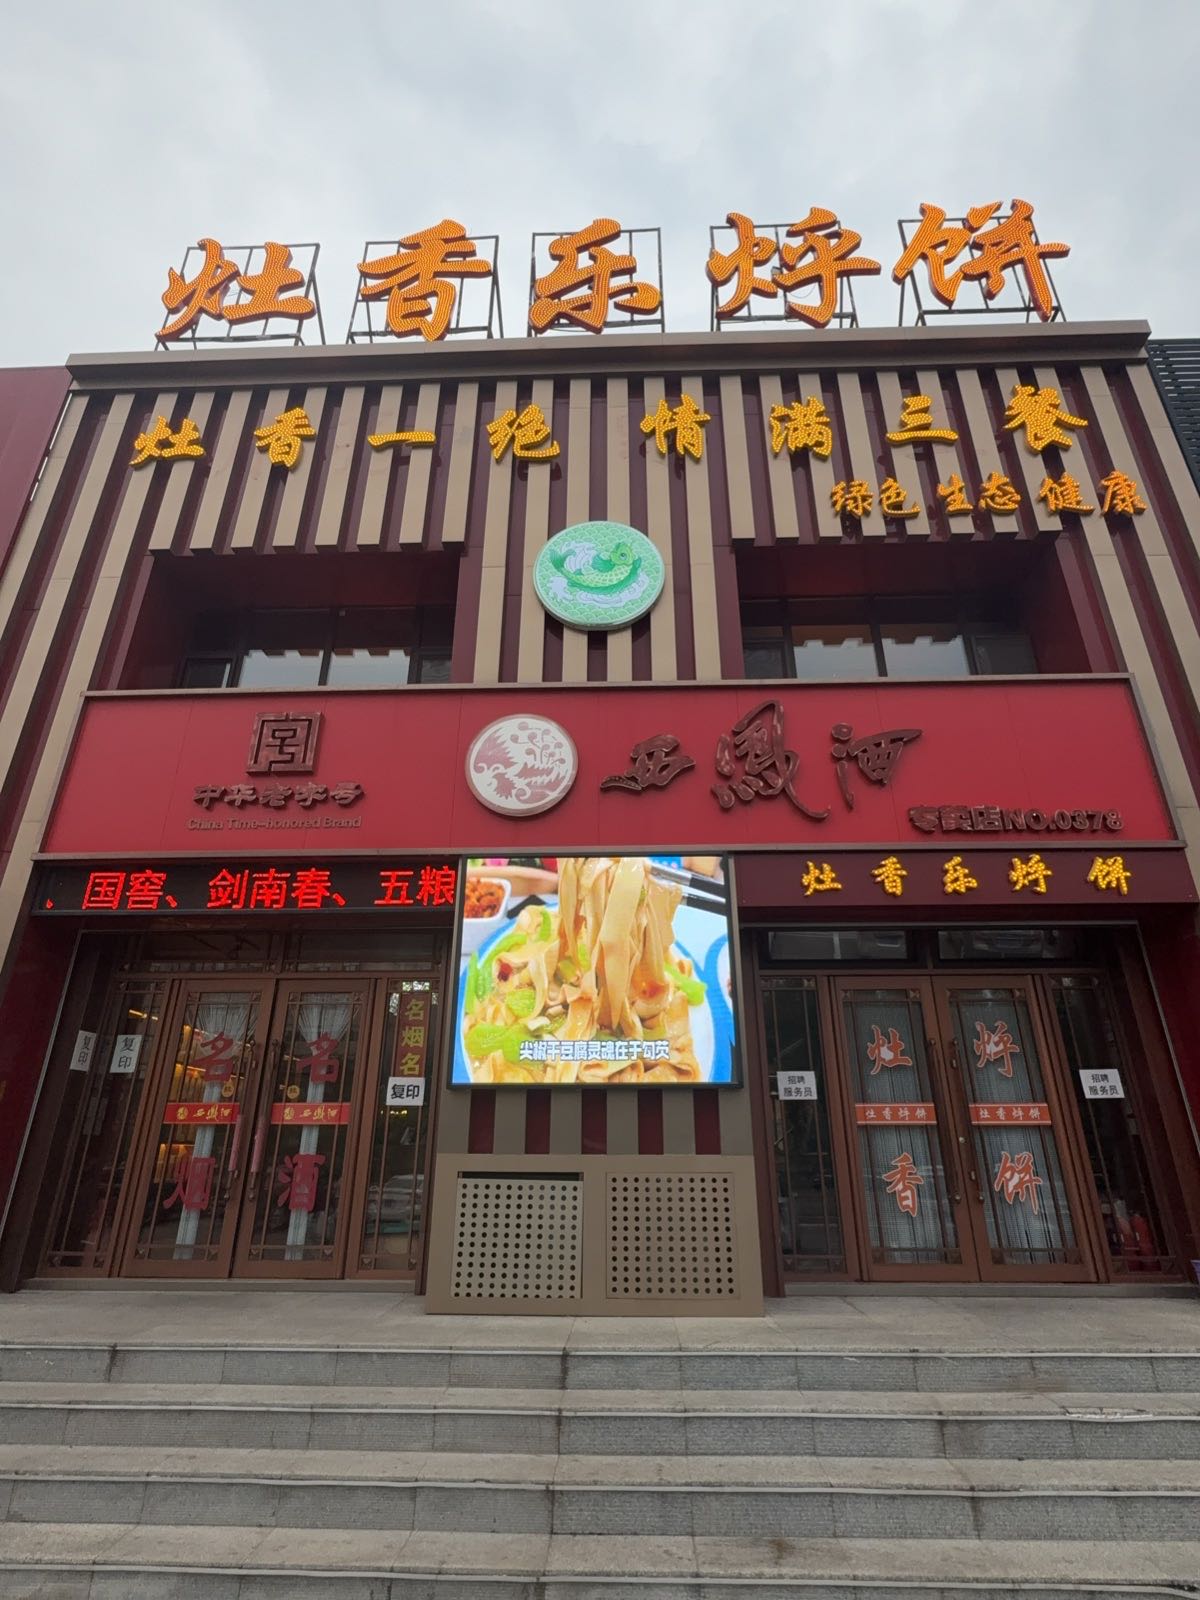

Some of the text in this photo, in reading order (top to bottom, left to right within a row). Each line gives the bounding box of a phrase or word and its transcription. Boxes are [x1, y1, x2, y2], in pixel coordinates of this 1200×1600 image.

[154, 197, 1071, 342] 灶香乐烀饼
[193, 781, 365, 810] 中华老字号
[187, 818, 223, 829] China
[323, 815, 362, 829] Brand
[801, 853, 1132, 897] 灶香乐烀饼
[118, 1036, 136, 1069] 复印
[390, 1083, 420, 1099] 复印
[783, 1086, 813, 1097] 服务员
[1088, 1085, 1119, 1096] 服务员
